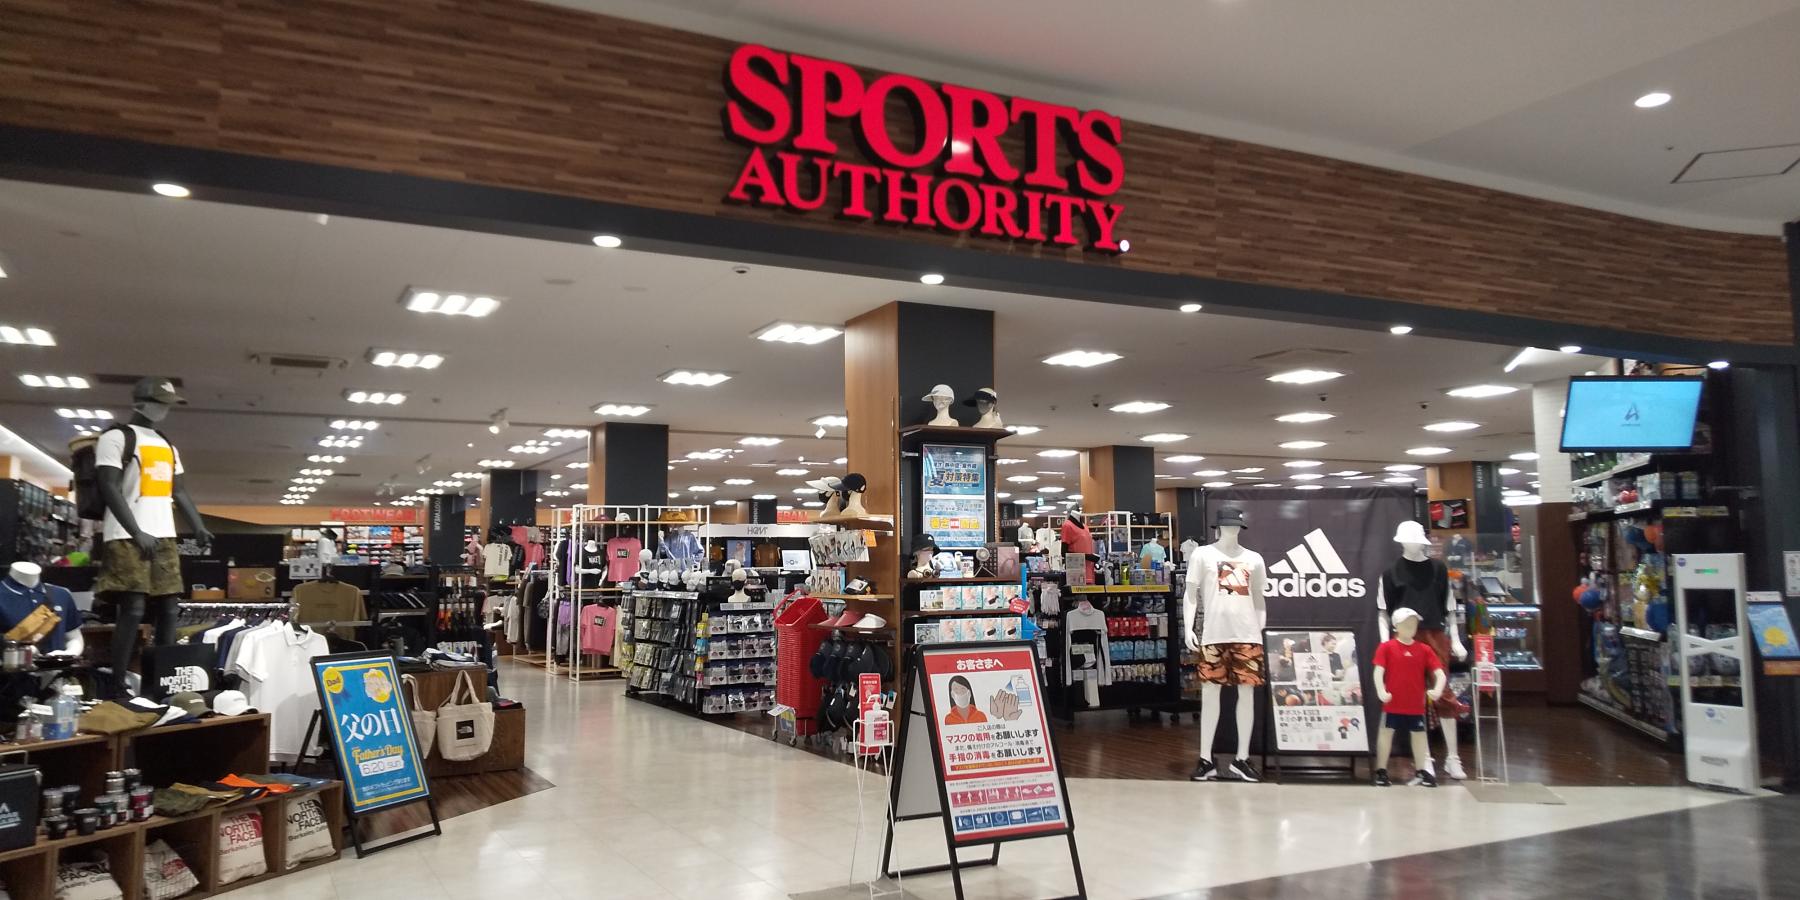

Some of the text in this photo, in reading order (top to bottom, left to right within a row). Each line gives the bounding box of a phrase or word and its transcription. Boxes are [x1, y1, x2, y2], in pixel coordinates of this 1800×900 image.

[727, 43, 1125, 197] SPORTS
[1263, 572, 1367, 598] adidas
[174, 666, 194, 676] THE
[956, 658, 1004, 671] お客さまへ
[160, 675, 193, 687] NORTH
[326, 676, 341, 687] Dad
[340, 707, 402, 744] 父の日
[298, 800, 315, 811] THE
[231, 814, 251, 824] THE
[287, 808, 319, 825] NORTH
[299, 817, 321, 831] FACE
[230, 831, 257, 844] FACE
